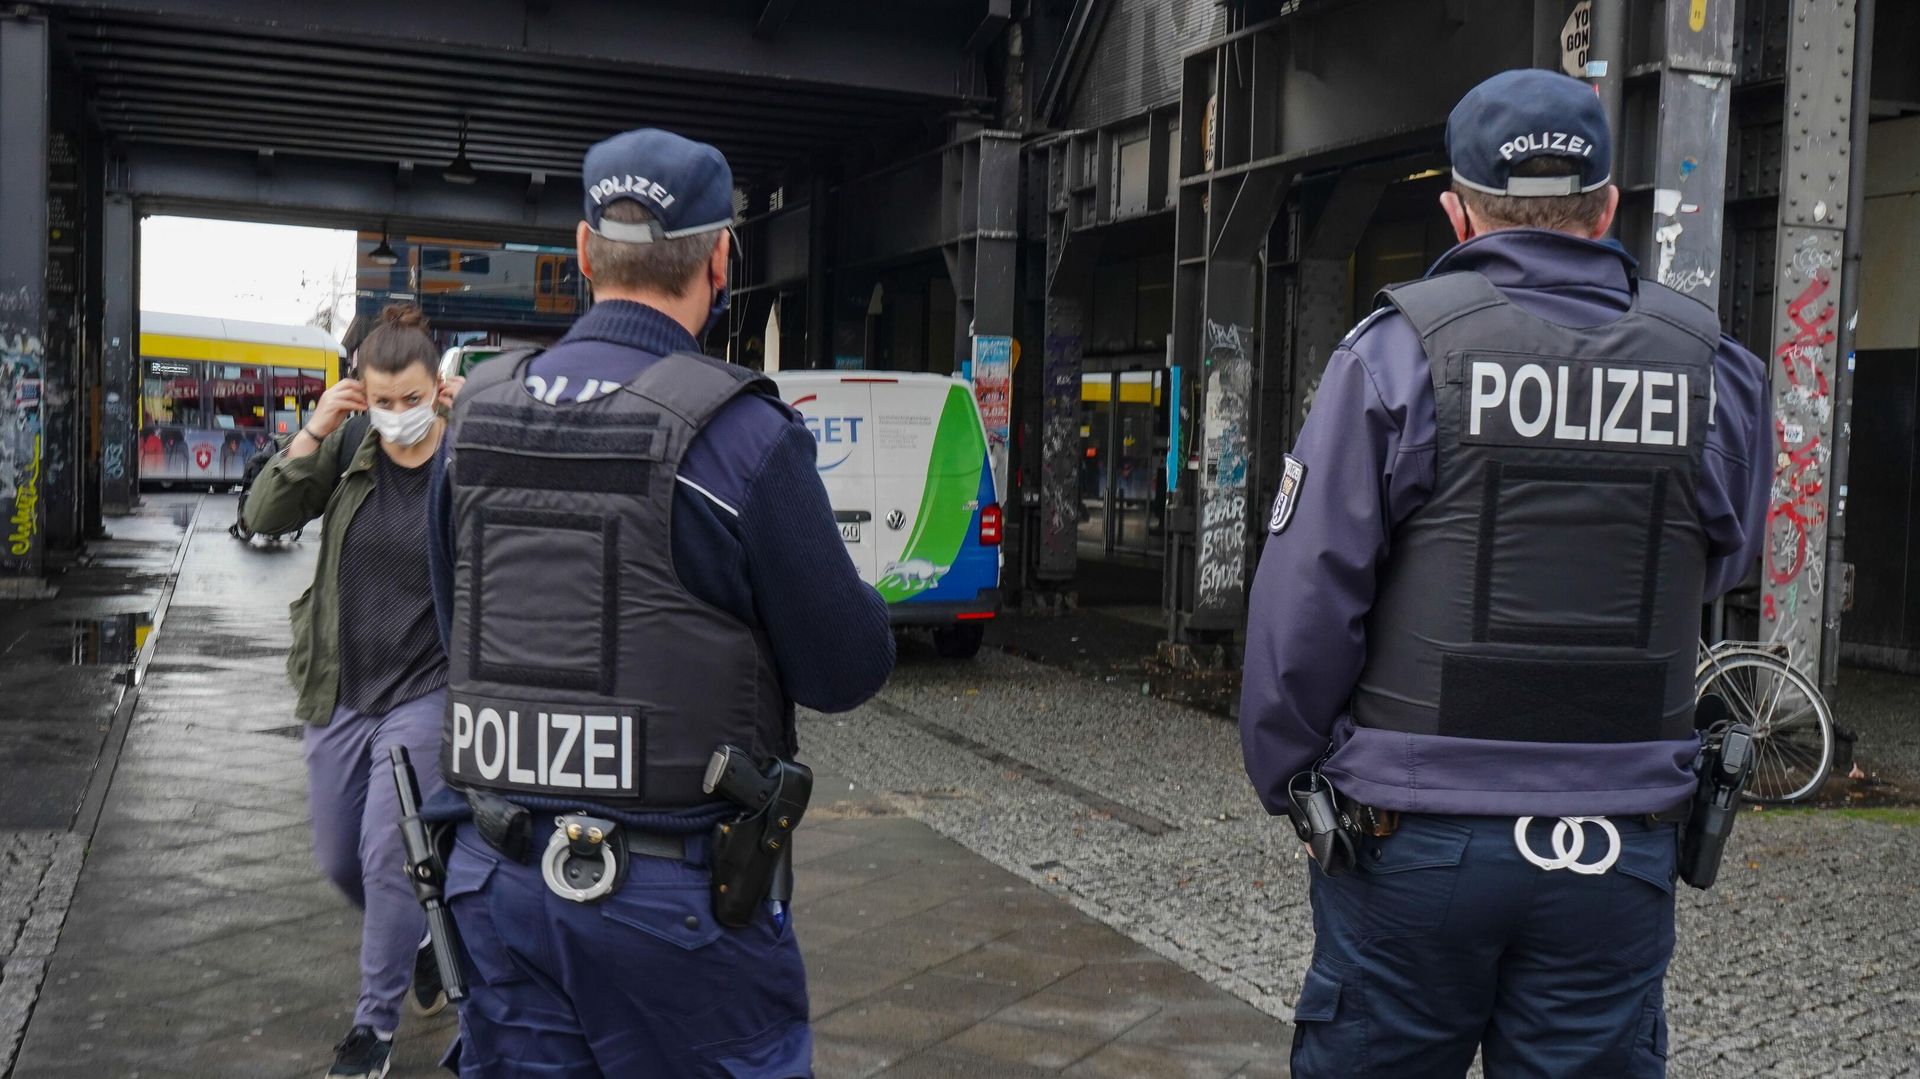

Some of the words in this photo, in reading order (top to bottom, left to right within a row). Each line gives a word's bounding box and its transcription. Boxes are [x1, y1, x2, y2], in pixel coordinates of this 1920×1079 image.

[1498, 132, 1593, 161] POLIZEI
[589, 174, 675, 209] POLIZEI
[1469, 361, 1688, 447] POLIZEI
[452, 702, 632, 789] POLIZEI
